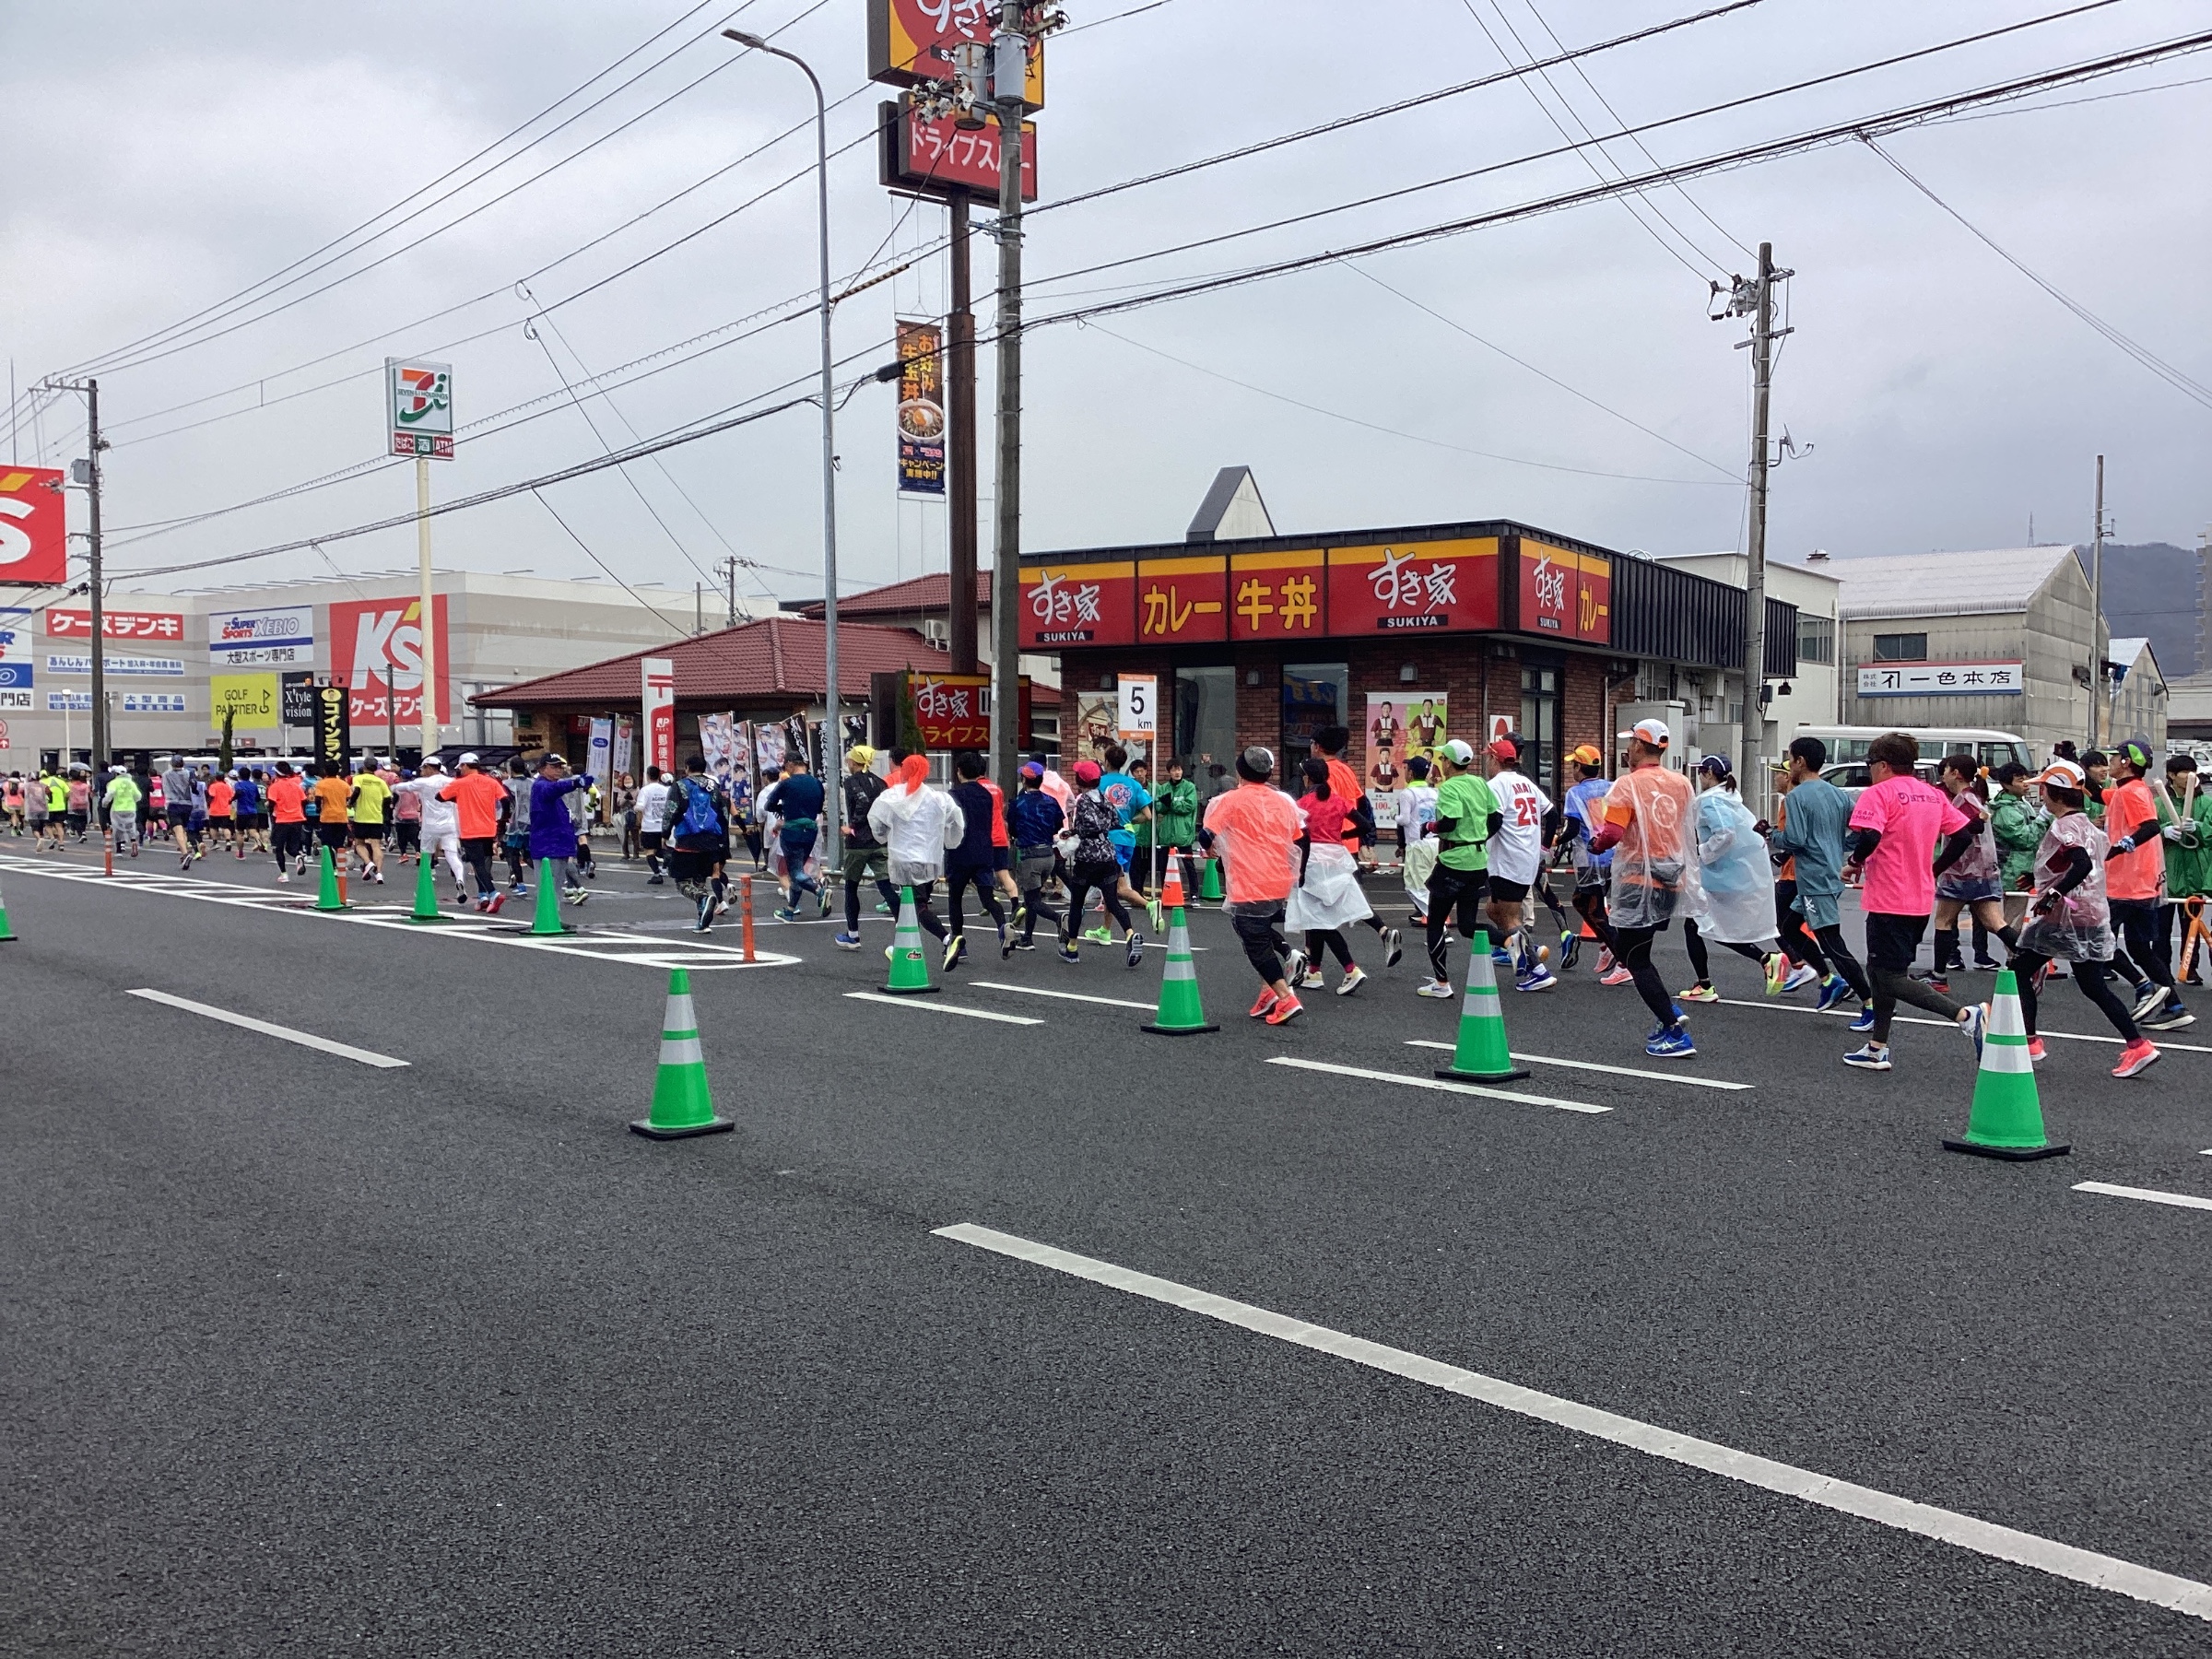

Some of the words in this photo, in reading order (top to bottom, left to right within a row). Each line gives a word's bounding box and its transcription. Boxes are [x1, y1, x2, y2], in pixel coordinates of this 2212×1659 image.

[912, 122, 1030, 173] ドライブスー
[395, 436, 414, 450] たばこ
[418, 438, 430, 452] 酒
[435, 440, 453, 453] ATM
[900, 458, 943, 470] キャンペーン
[1367, 547, 1457, 615] すき家
[1533, 547, 1564, 617] すき家
[1027, 570, 1100, 630] すき家
[1236, 574, 1318, 631] 牛丼
[1580, 581, 1608, 631] カレー
[1143, 584, 1222, 635] カレー
[52, 613, 179, 637] ケーズデンキ
[230, 617, 255, 629] SUPER
[254, 617, 300, 637] XEBIO
[1386, 615, 1439, 628] SUKIYA
[1540, 617, 1559, 629] SUKIYA
[221, 627, 253, 640] SPORTS
[1043, 631, 1086, 641] SUKIYA
[50, 656, 125, 668] あんしんパポート
[227, 648, 295, 665] 大型スポーツ専門店
[126, 694, 183, 703] 大型商品
[225, 689, 248, 700] GOLF
[917, 676, 970, 723] すき家
[1131, 687, 1145, 715] 5
[216, 703, 257, 715] PATNER
[285, 706, 312, 717] vision
[1137, 718, 1152, 729] km
[324, 702, 342, 763] コインラン
[919, 725, 991, 744] ライブス
[657, 735, 668, 772] 郵便局
[1512, 782, 1532, 795] ARAI
[1514, 796, 1538, 827] 25
